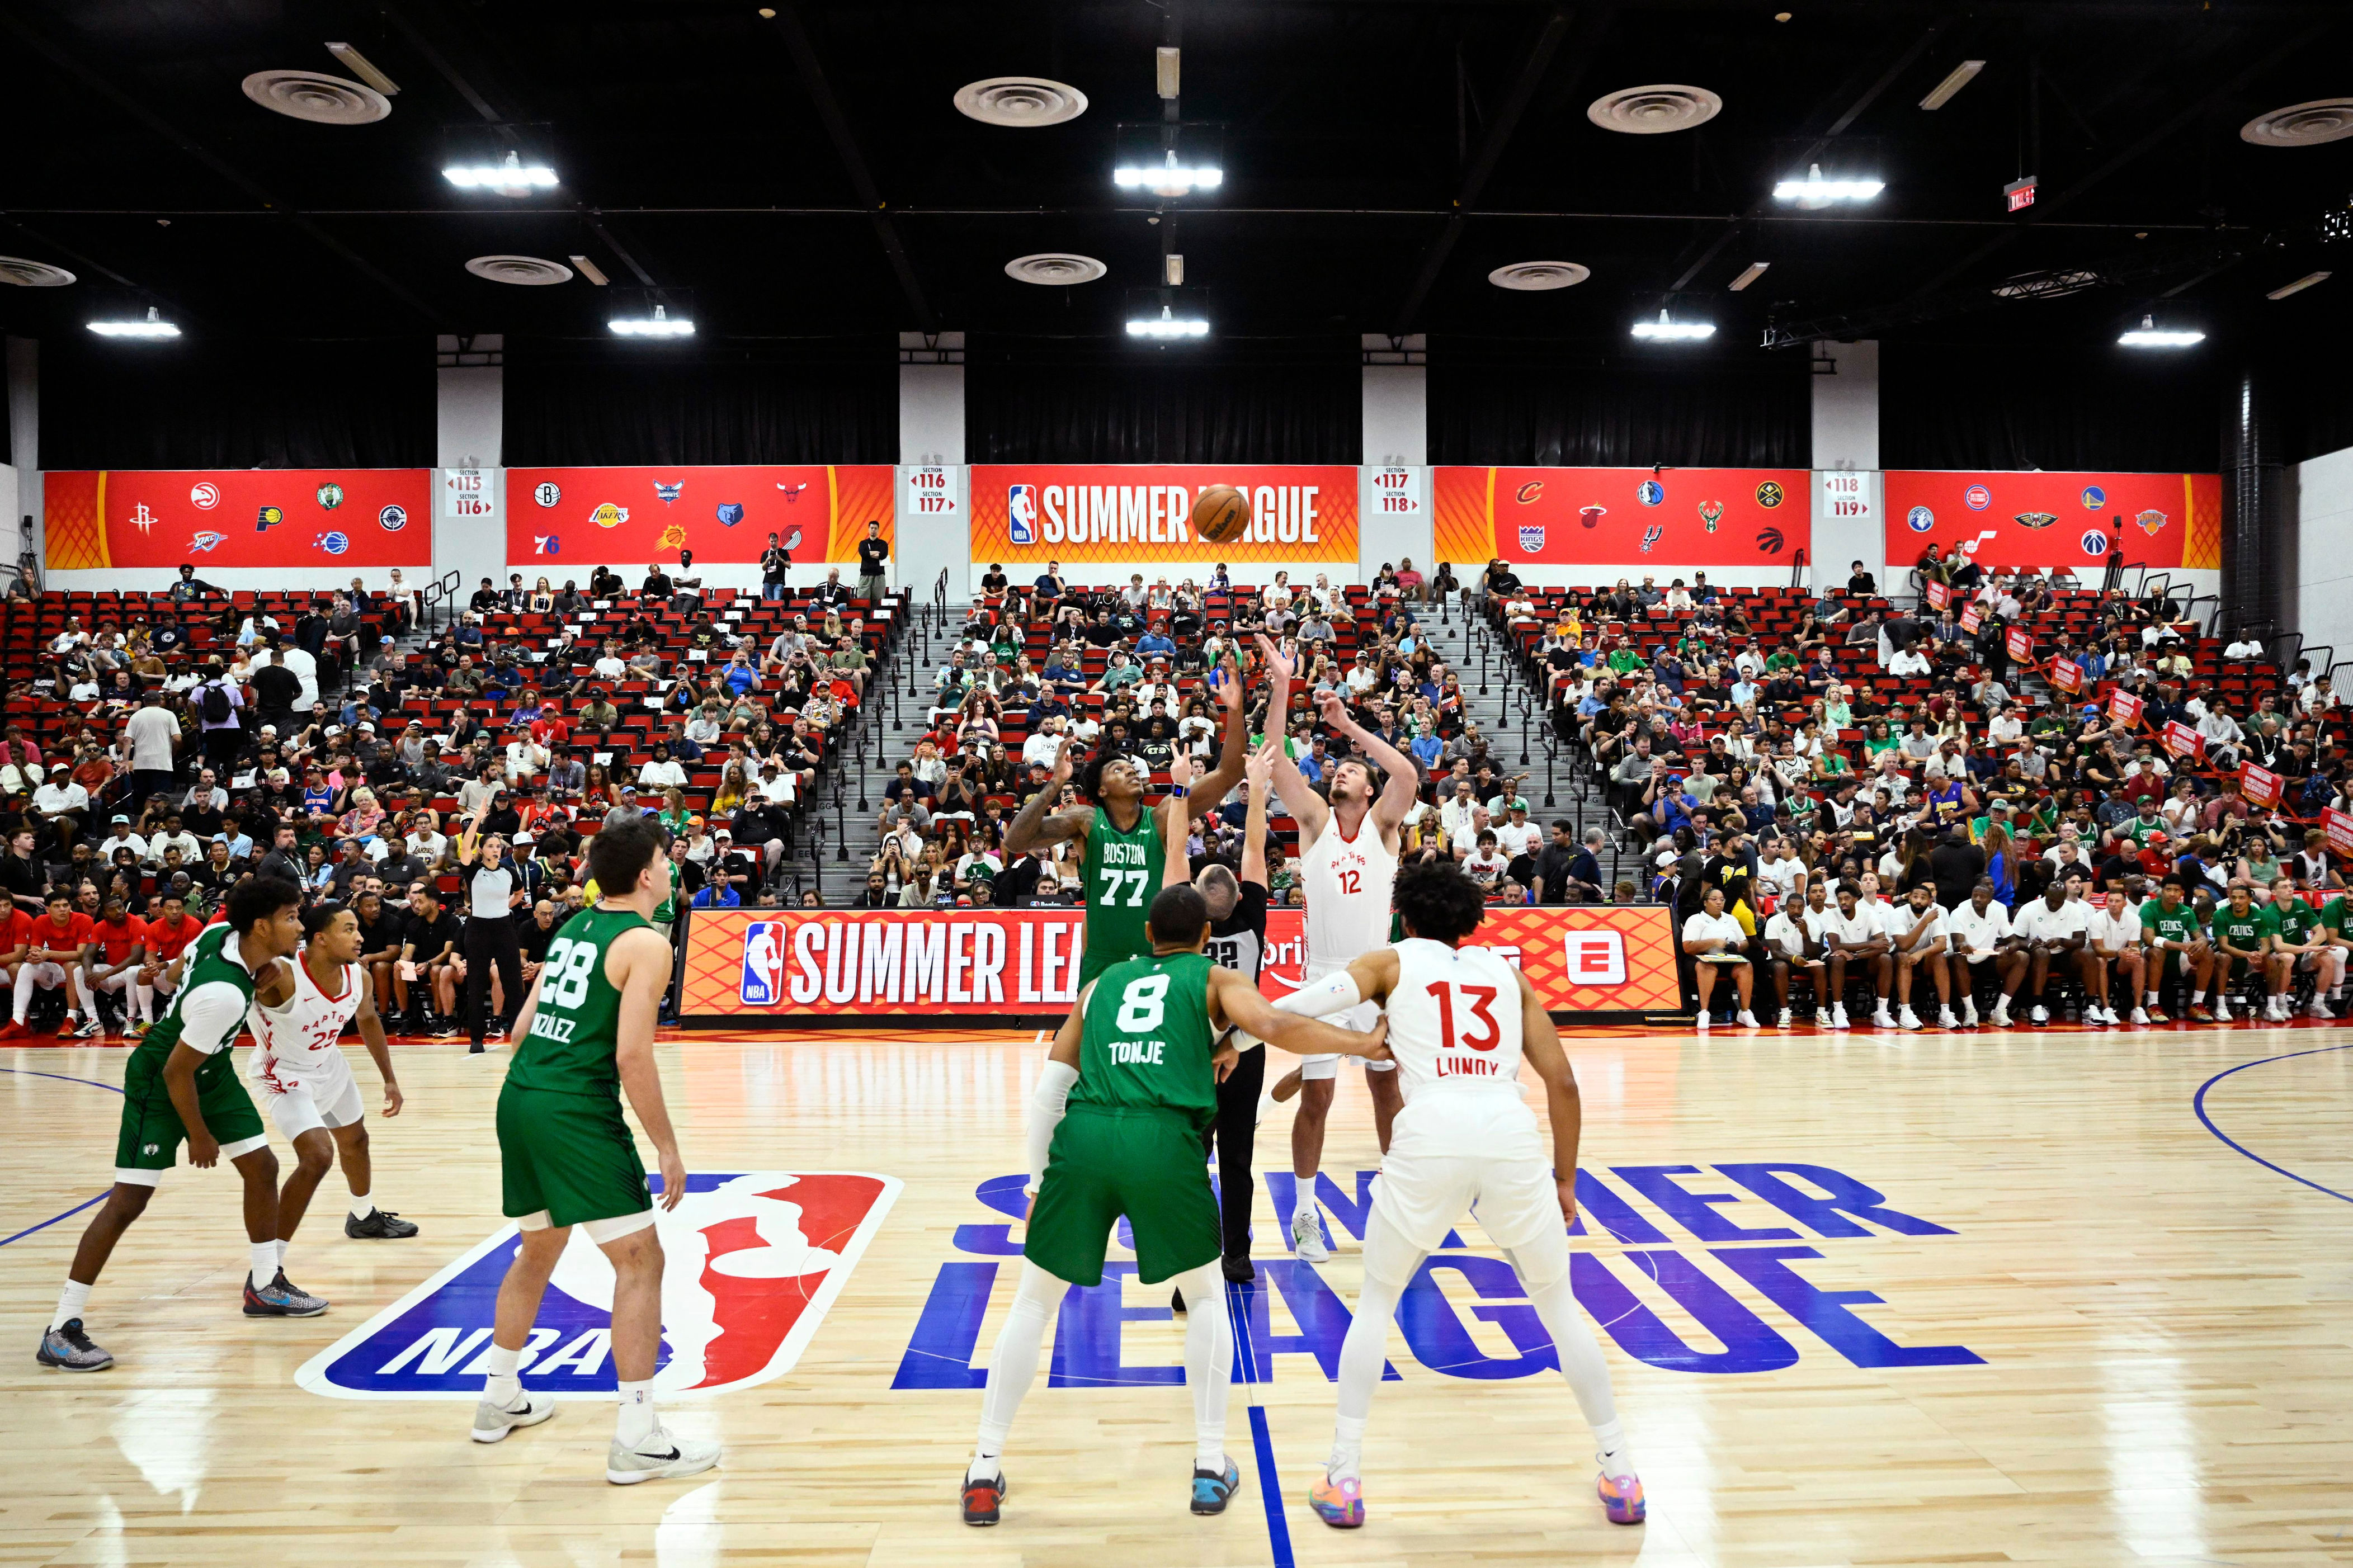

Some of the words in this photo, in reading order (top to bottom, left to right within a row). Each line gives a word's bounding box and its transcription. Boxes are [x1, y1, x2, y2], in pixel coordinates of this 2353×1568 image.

[456, 476, 482, 490] 115
[919, 474, 945, 488] 116
[1383, 474, 1408, 488] 117
[1834, 478, 1859, 492] 118
[456, 500, 482, 514] 116
[919, 498, 945, 512] 117
[1383, 498, 1408, 512] 118
[1834, 502, 1859, 516] 119
[592, 509, 625, 522] LAKERS
[1043, 485, 1189, 543] SUMMER
[1198, 485, 1319, 543] GUE
[195, 534, 215, 547] OKC
[1013, 530, 1027, 540] NBA
[534, 535, 560, 554] 76
[518, 715, 540, 726] TORONT
[413, 846, 435, 854] LAKERS
[1104, 842, 1146, 866] BOSTON
[1100, 867, 1149, 906] 77
[1338, 870, 1362, 894] 12
[2159, 920, 2183, 932] CELTICS
[2229, 925, 2254, 937] CELTICS
[1260, 935, 1302, 970] pri
[790, 922, 1006, 1004] SUMMER
[1018, 922, 1086, 1003] LEA
[538, 937, 598, 1010] 28
[746, 985, 765, 999] NBA
[1115, 973, 1171, 1033] 8
[301, 1010, 348, 1032] RAPTOR
[1426, 980, 1500, 1051] 13
[529, 1010, 576, 1044] NZÁLEZ
[308, 1029, 339, 1051] 25
[1108, 1041, 1166, 1066] TONJE
